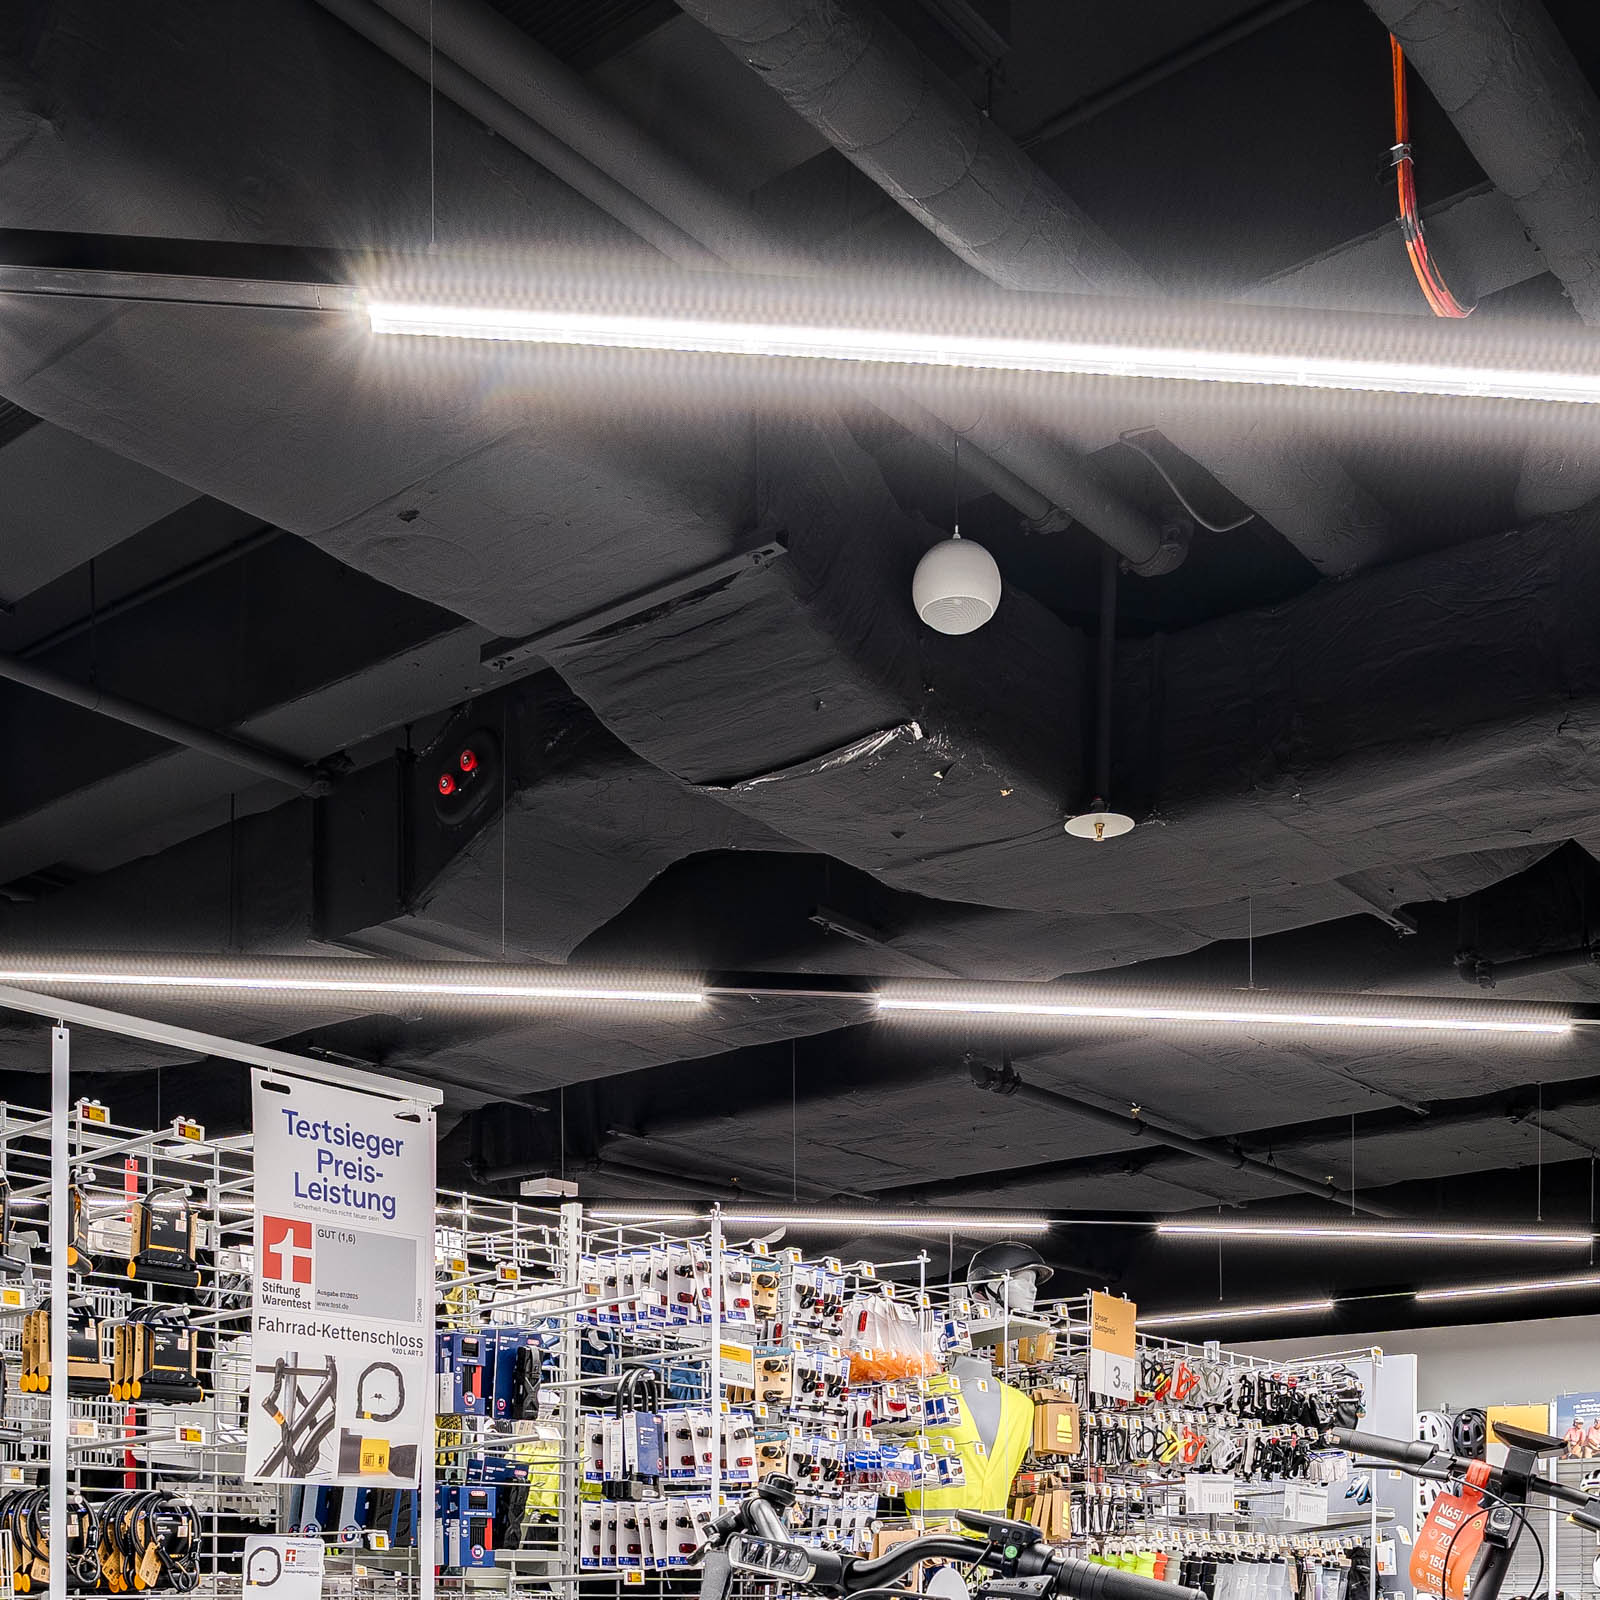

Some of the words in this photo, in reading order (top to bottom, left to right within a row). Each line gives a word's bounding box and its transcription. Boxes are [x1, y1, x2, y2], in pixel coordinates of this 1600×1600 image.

[282, 1108, 404, 1159] Testsieger
[317, 1149, 384, 1184] Preis-
[294, 1172, 396, 1220] Leistung
[293, 1202, 322, 1213] Sicherheit
[322, 1207, 338, 1215] muss
[317, 1229, 336, 1240] GUT
[338, 1233, 356, 1245] (1,6)
[262, 1281, 301, 1298] Stiftung
[316, 1288, 339, 1299] Ausgabe
[261, 1294, 312, 1310] Warentest
[316, 1301, 349, 1311] www.test.de
[258, 1316, 425, 1349] Fahrrad-Kettenschloss
